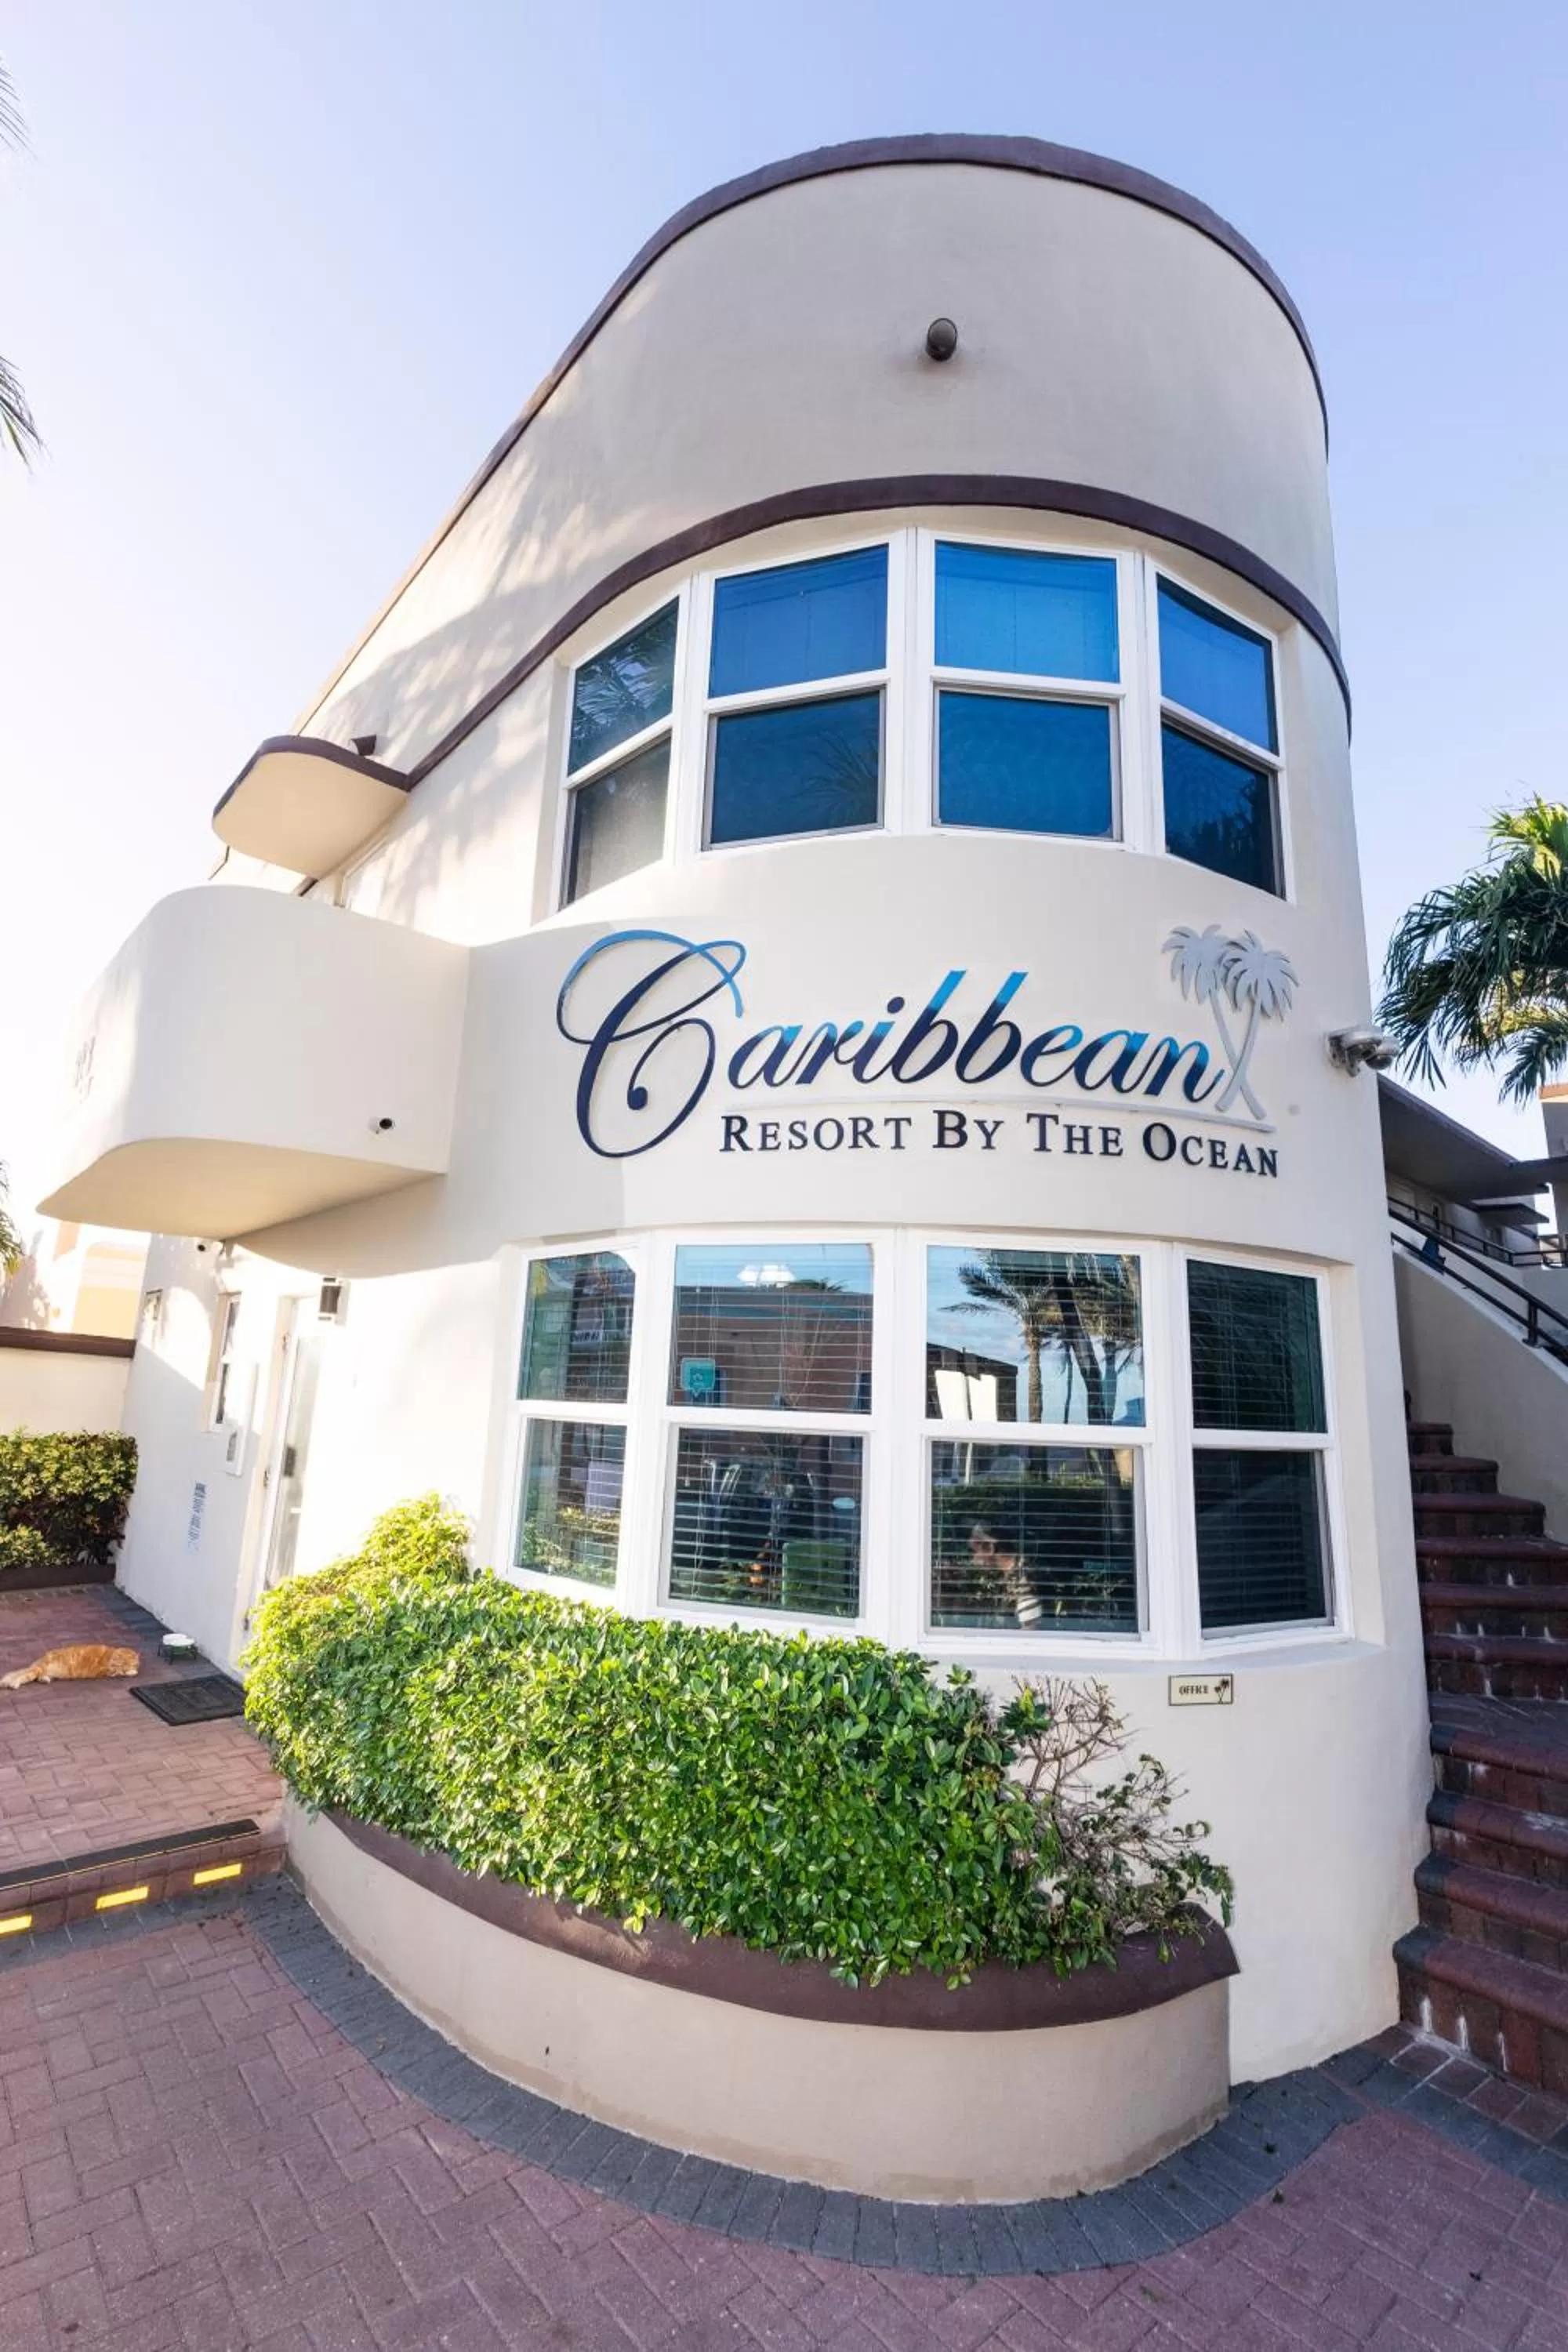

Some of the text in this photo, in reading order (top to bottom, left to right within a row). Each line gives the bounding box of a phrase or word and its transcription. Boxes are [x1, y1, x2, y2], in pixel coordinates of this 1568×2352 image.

[556, 930, 1225, 1159] Caribbean
[720, 1109, 1278, 1178] RESORT BY THE OCEAN
